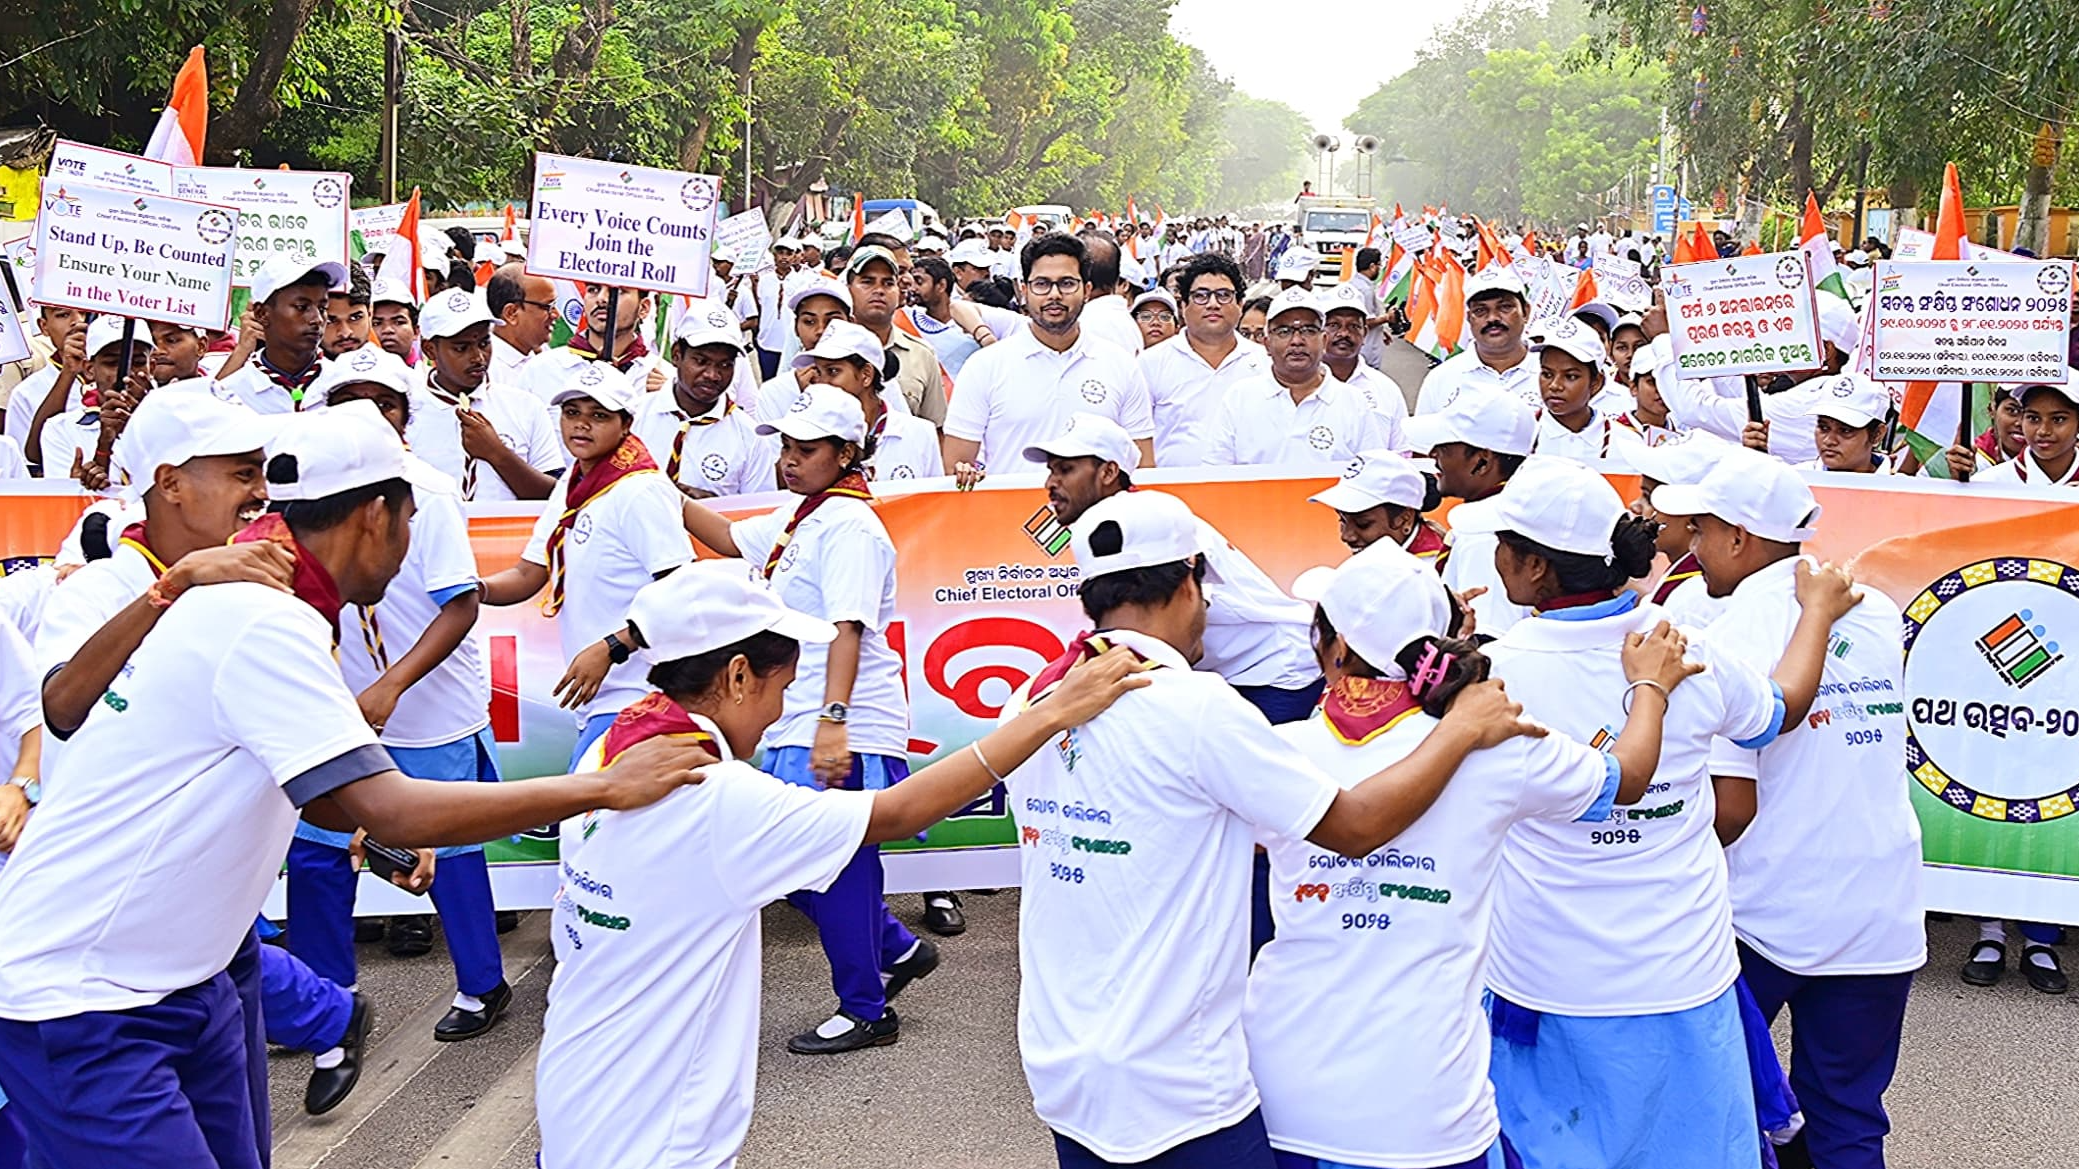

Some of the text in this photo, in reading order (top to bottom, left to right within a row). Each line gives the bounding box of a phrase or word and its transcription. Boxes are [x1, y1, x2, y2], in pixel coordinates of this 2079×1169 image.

[58, 157, 86, 170] VOTE
[537, 201, 707, 241] Every Voice Counts
[49, 225, 95, 246] Stand
[102, 233, 129, 254] Up,
[134, 239, 155, 255] Be
[159, 243, 226, 268] Counted
[585, 231, 654, 257] Join the
[58, 253, 211, 292] Ensure Your Name
[559, 251, 676, 284] Electoral Roll
[66, 281, 196, 316] in the Voter List
[1680, 298, 1703, 318] ଫର୍ମ
[1919, 291, 1958, 313] ସଂକ୍ଷିପ୍ତ
[1962, 296, 2021, 312] ସଂଶୋଧନ
[1722, 321, 1755, 340] କରନ୍ତୁ
[1758, 319, 1769, 332] ଓ
[1773, 316, 1794, 332] ଏକ
[1679, 342, 1813, 368] ସଚେତନ ନାଗରିକ ହୁଅନ୍ତୁ
[965, 569, 994, 584] ମୁଖ୍ୟ
[998, 565, 1045, 580] ନିର୍ବାଚନ
[935, 587, 978, 602] Chief
[982, 585, 1052, 600] Electoral
[1849, 676, 1894, 692] ତାଲିକାର
[1912, 697, 1957, 726] ପଥ
[1845, 728, 1883, 746] ୨୦୨୫
[1591, 829, 1642, 845] ୨୦୨୫
[1367, 848, 1436, 872] ତାଲିକାର
[1379, 883, 1452, 904] ସଂଶୋଧନ
[1342, 913, 1391, 930] ୨୦୨୫
